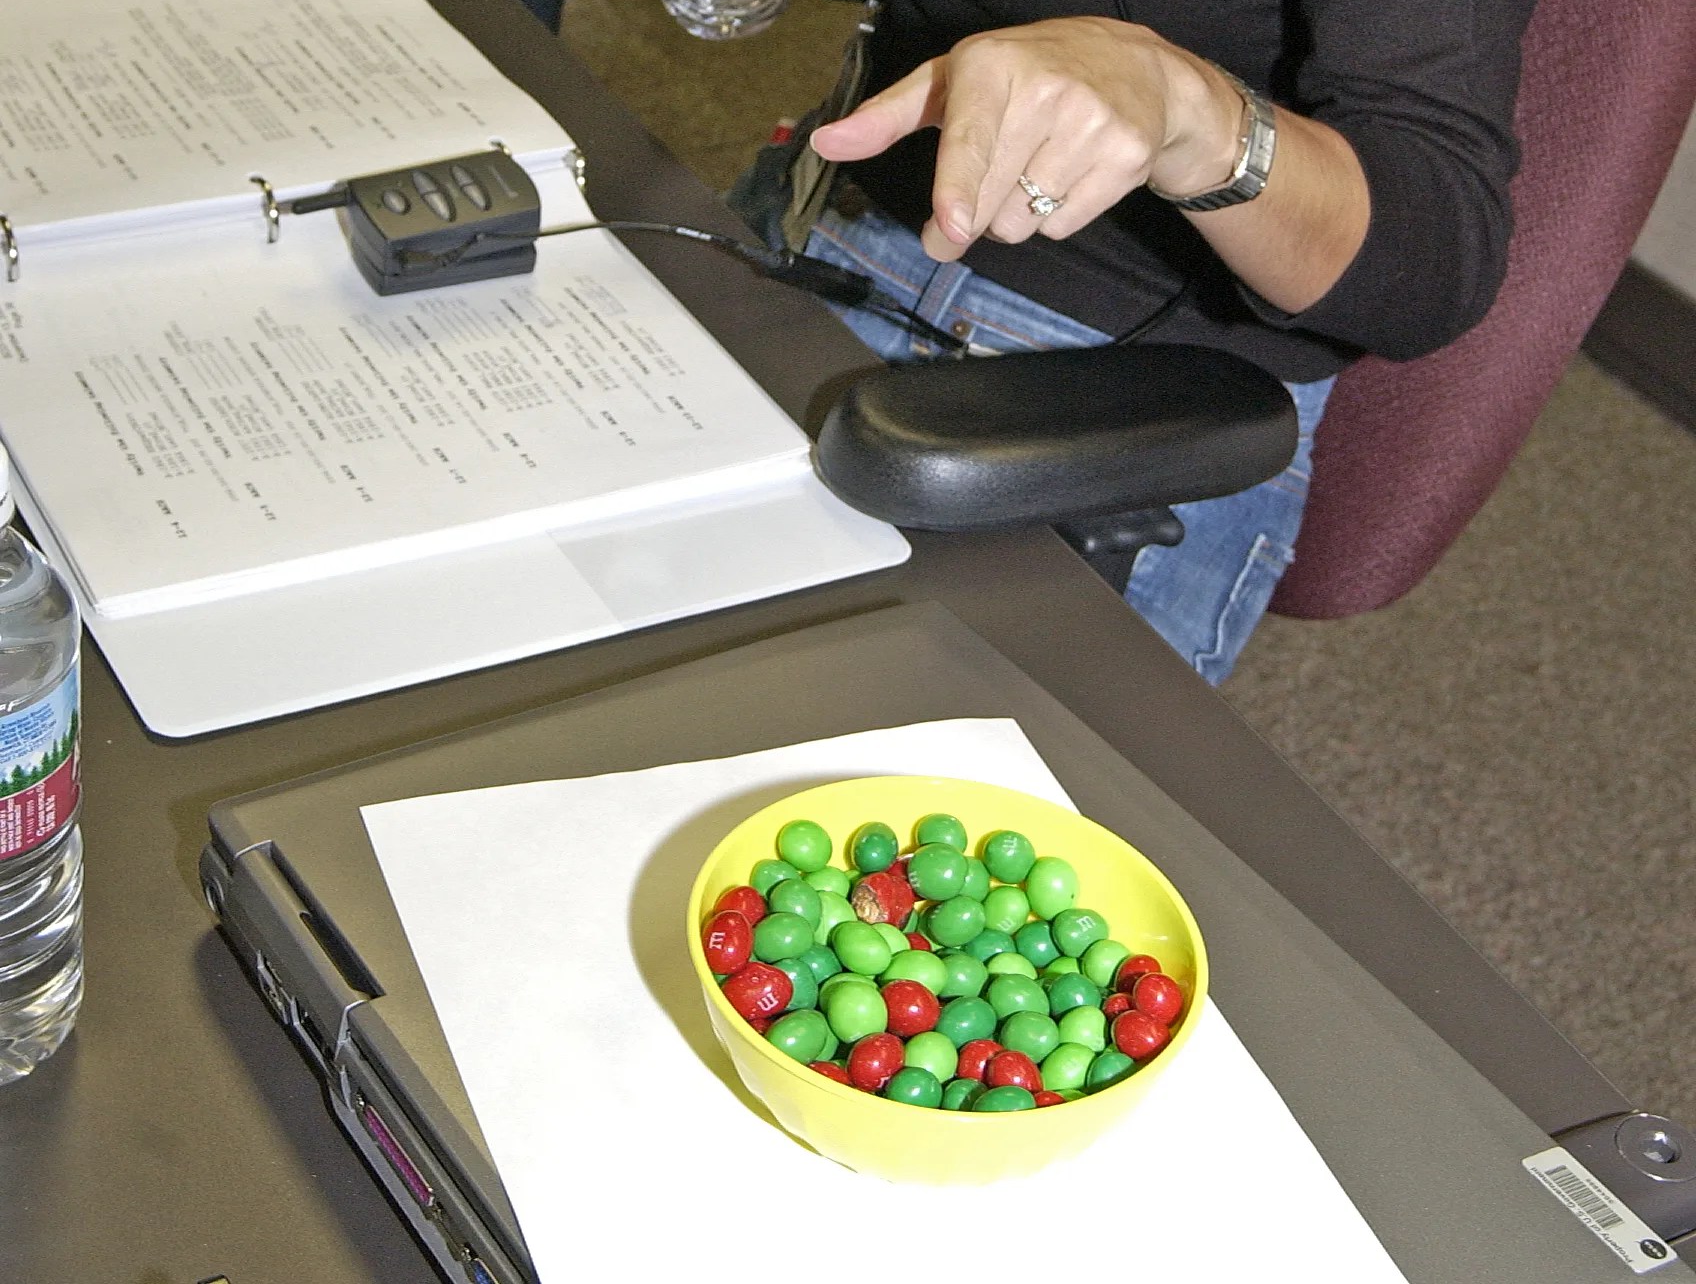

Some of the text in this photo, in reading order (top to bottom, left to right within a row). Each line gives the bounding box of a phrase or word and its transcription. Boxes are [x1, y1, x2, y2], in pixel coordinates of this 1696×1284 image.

[1076, 915, 1096, 932] m
[709, 932, 726, 950] m
[757, 992, 779, 1011] m
[1530, 1168, 1576, 1209] Government
[1591, 1222, 1600, 1233] of
[1601, 1232, 1633, 1263] Property
